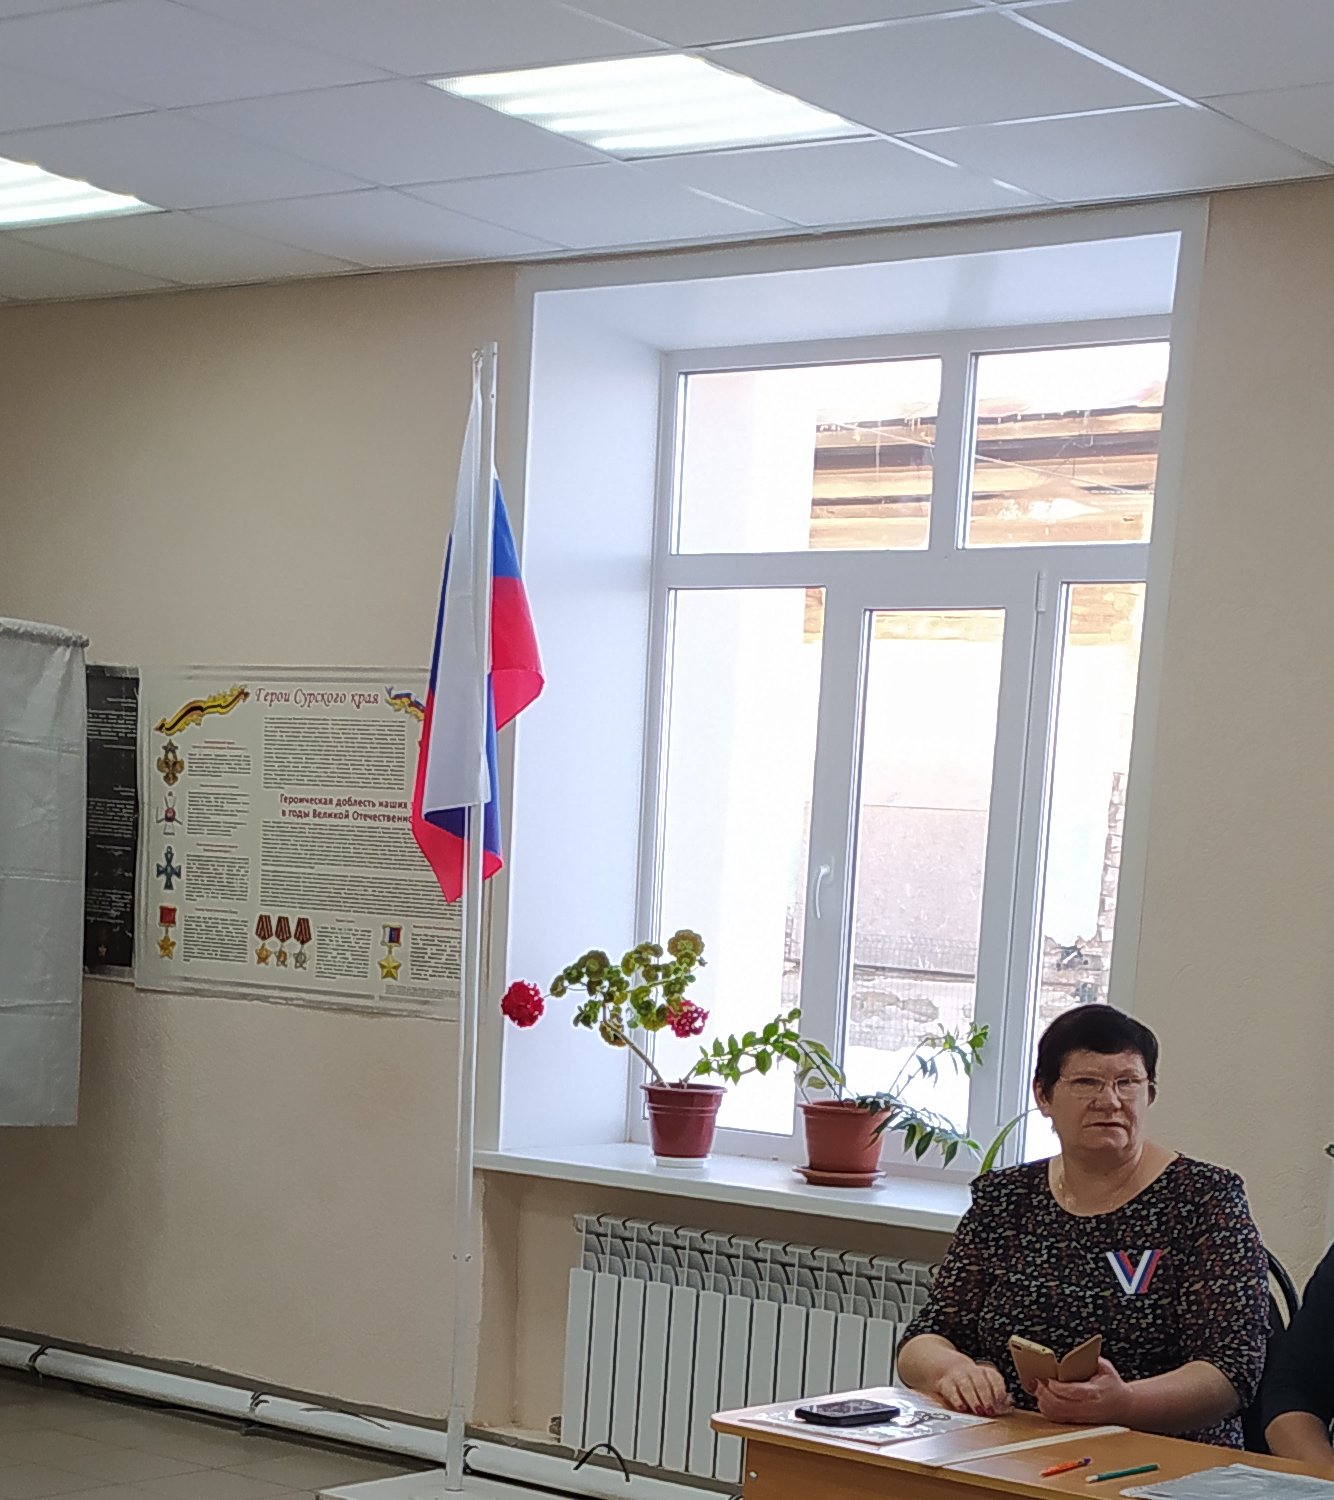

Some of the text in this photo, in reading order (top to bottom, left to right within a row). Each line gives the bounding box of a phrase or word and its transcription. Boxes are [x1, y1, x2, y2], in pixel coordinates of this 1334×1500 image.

[255, 687, 380, 709] Герои Сурского края
[280, 793, 408, 810] Героическая доблесть наших
[281, 808, 413, 824] в годы Великой Отечественно
